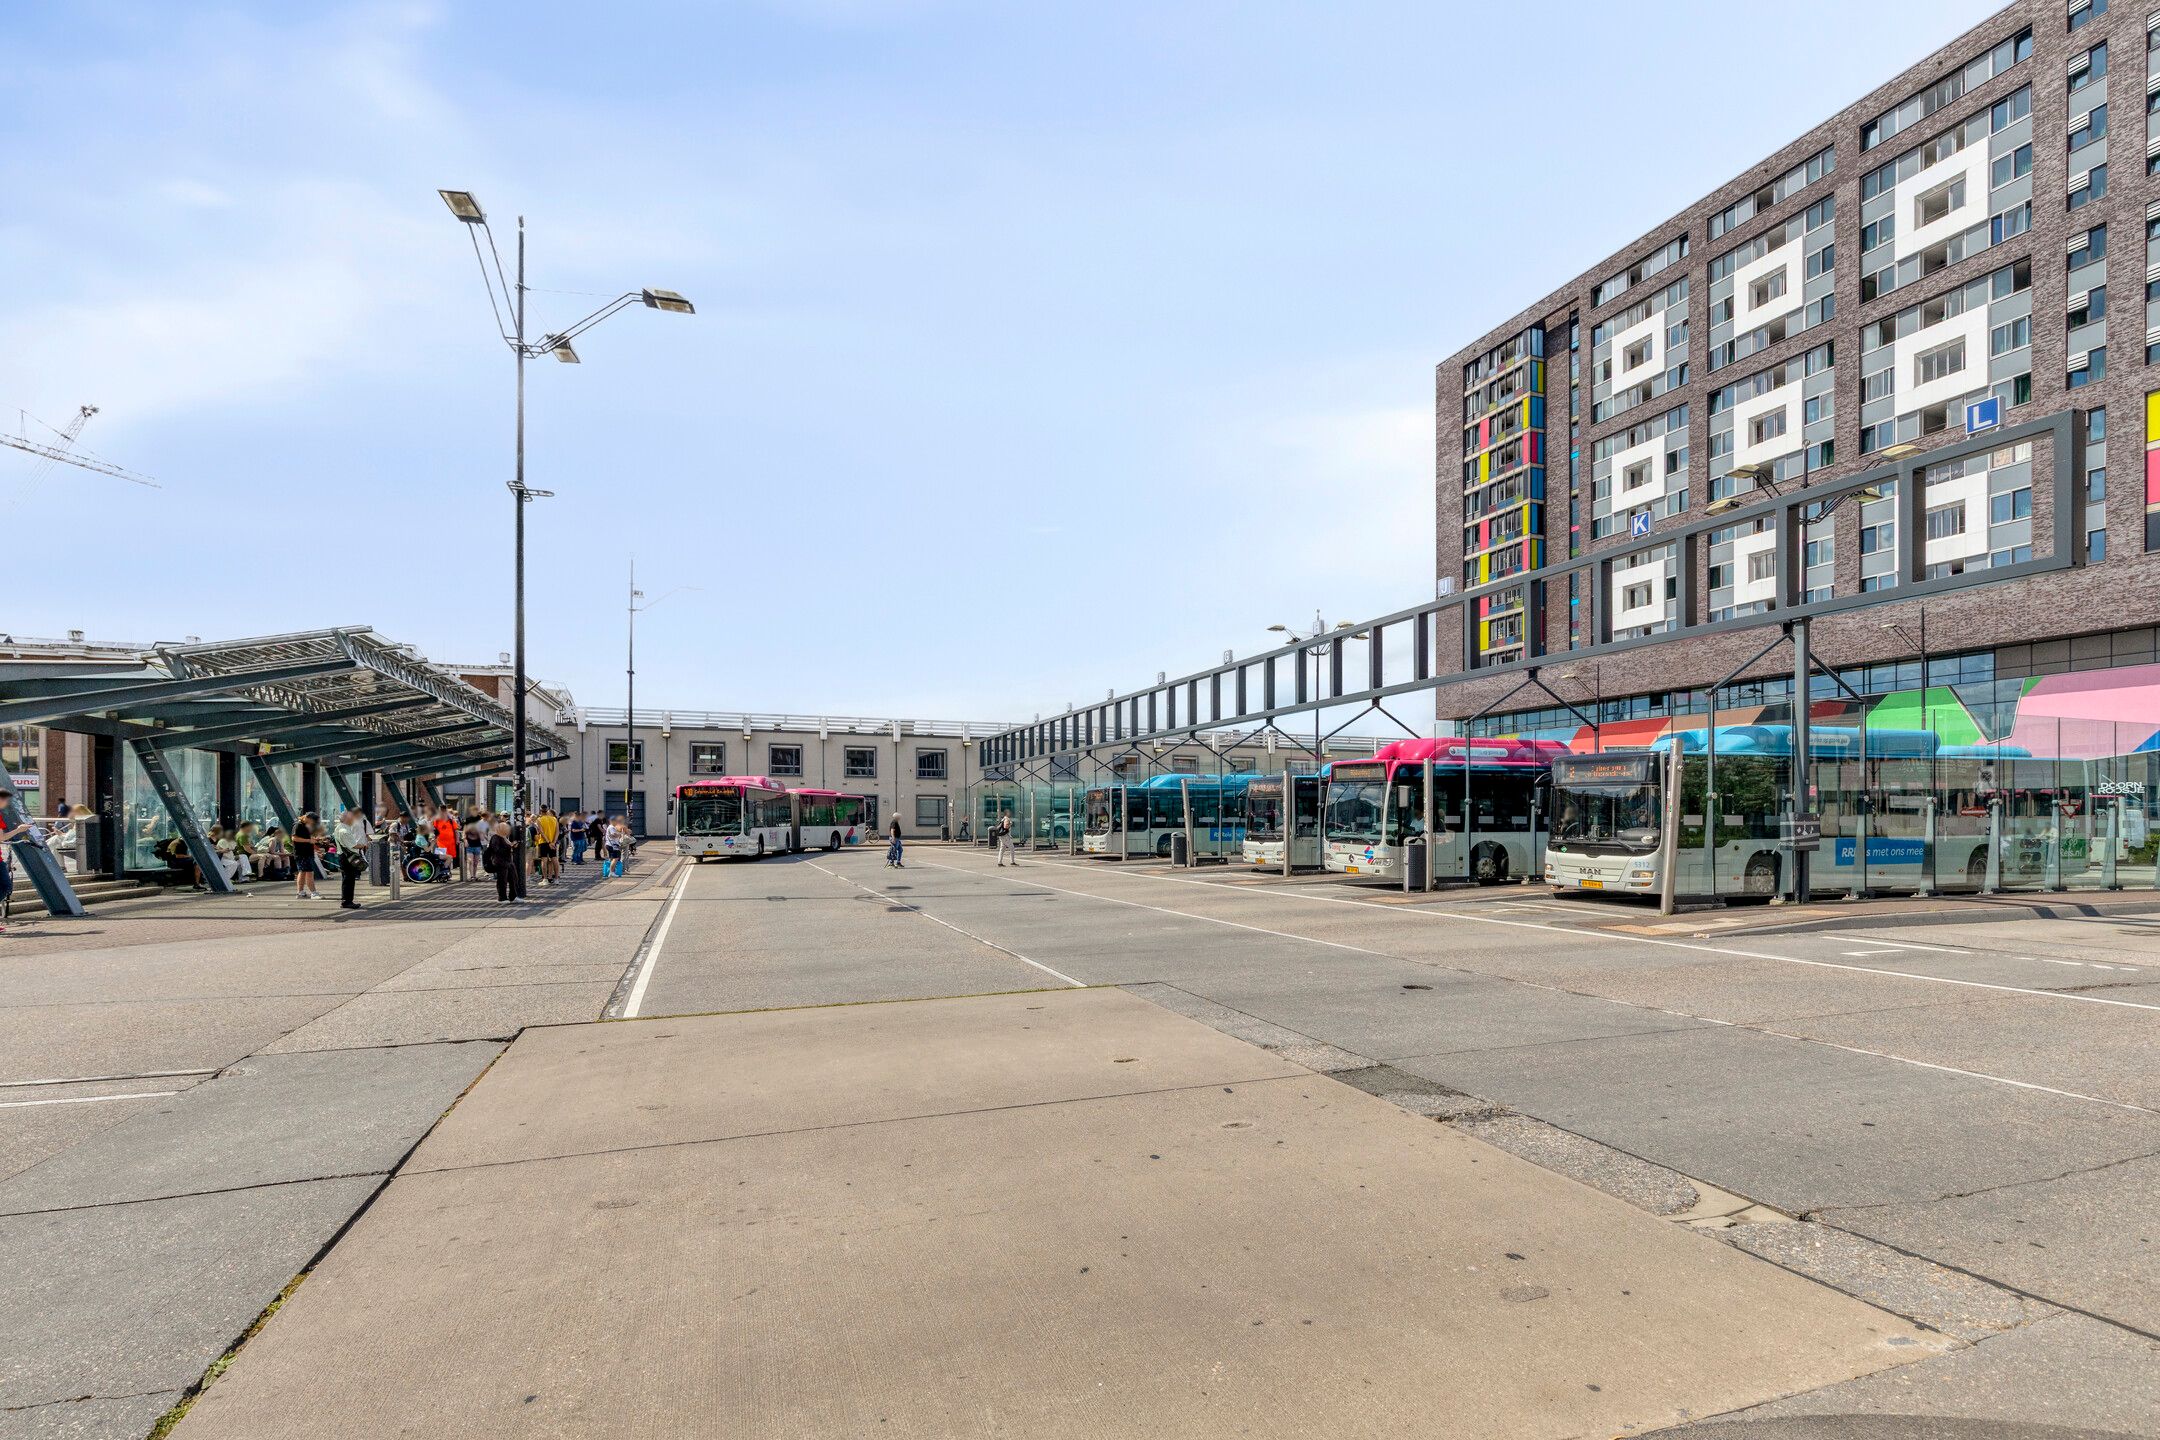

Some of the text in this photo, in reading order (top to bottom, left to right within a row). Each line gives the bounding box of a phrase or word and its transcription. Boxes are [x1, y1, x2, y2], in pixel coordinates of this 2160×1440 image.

[1973, 405, 1992, 430] L
[1633, 513, 1647, 535] K
[2097, 786, 2146, 794] ROOSJE
[1841, 847, 1924, 858] RRs met ons mee
[1579, 867, 1602, 875] MAN
